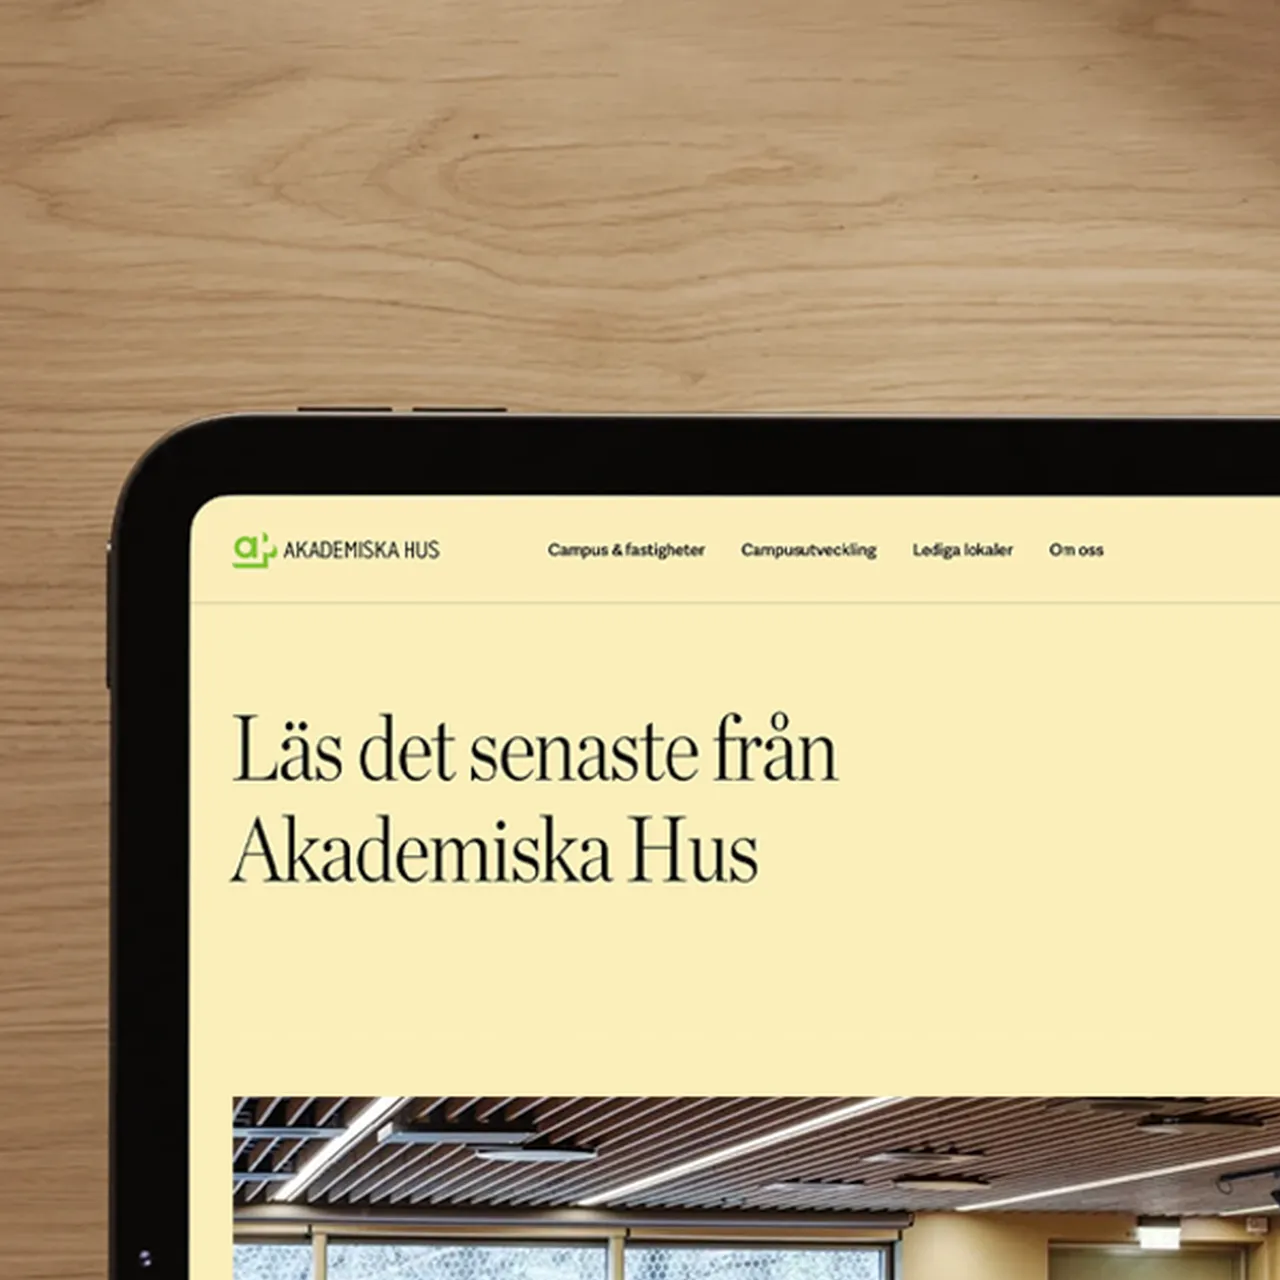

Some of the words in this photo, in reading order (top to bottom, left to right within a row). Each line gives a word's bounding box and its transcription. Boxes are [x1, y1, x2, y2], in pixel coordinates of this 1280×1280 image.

[283, 540, 400, 559] AKADEMISKA
[404, 540, 440, 559] HUS
[548, 543, 609, 560] Campus
[612, 543, 624, 558] &
[625, 542, 706, 561] fastigheter
[741, 543, 878, 561] Campusutveckling
[913, 543, 961, 561] Lediga
[963, 543, 1014, 558] lokaler
[1049, 543, 1076, 558] Om
[1077, 546, 1105, 558] oss
[232, 713, 342, 782] Läs
[359, 712, 457, 782] det
[470, 721, 699, 782] senaste
[713, 710, 839, 782] från
[230, 813, 614, 884] Akademiska
[627, 814, 759, 884] Hus
